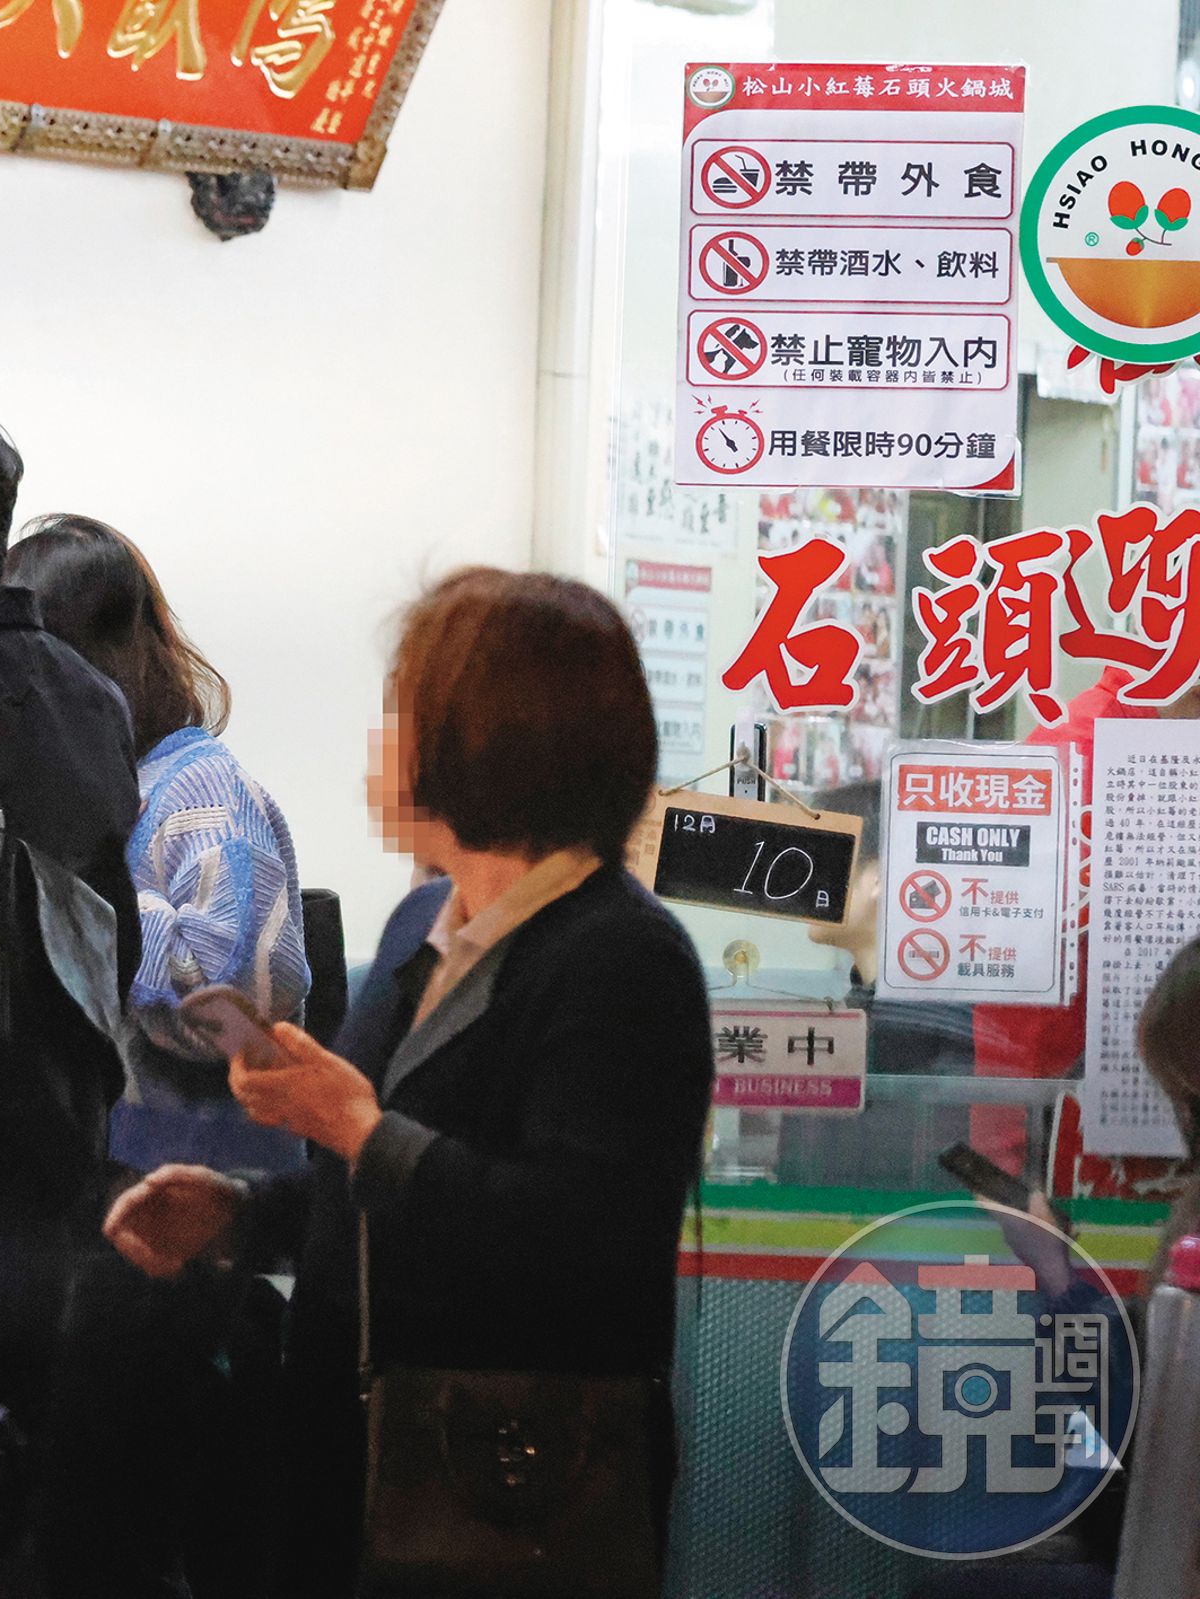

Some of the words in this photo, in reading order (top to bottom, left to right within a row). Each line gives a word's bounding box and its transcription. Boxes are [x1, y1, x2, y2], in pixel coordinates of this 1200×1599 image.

[742, 75, 1014, 99] 松山小紅莓石頭火鍋城
[775, 160, 1002, 198] 禁帶外食
[1052, 155, 1108, 229] HSIAO
[775, 248, 999, 279] 禁帶酒水、飲料
[768, 430, 996, 460] 用餐限時90分鐘
[903, 772, 1048, 810] 只收現金
[926, 825, 975, 847] CASH
[976, 827, 1020, 848] ONLY
[942, 848, 978, 863] Thank
[980, 849, 1003, 863] You
[961, 877, 1019, 905] 不提供
[959, 933, 1017, 962] 不提供
[957, 962, 1015, 978] 載具服務
[714, 1025, 835, 1065] 業中
[734, 1077, 833, 1098] BUSINESS
